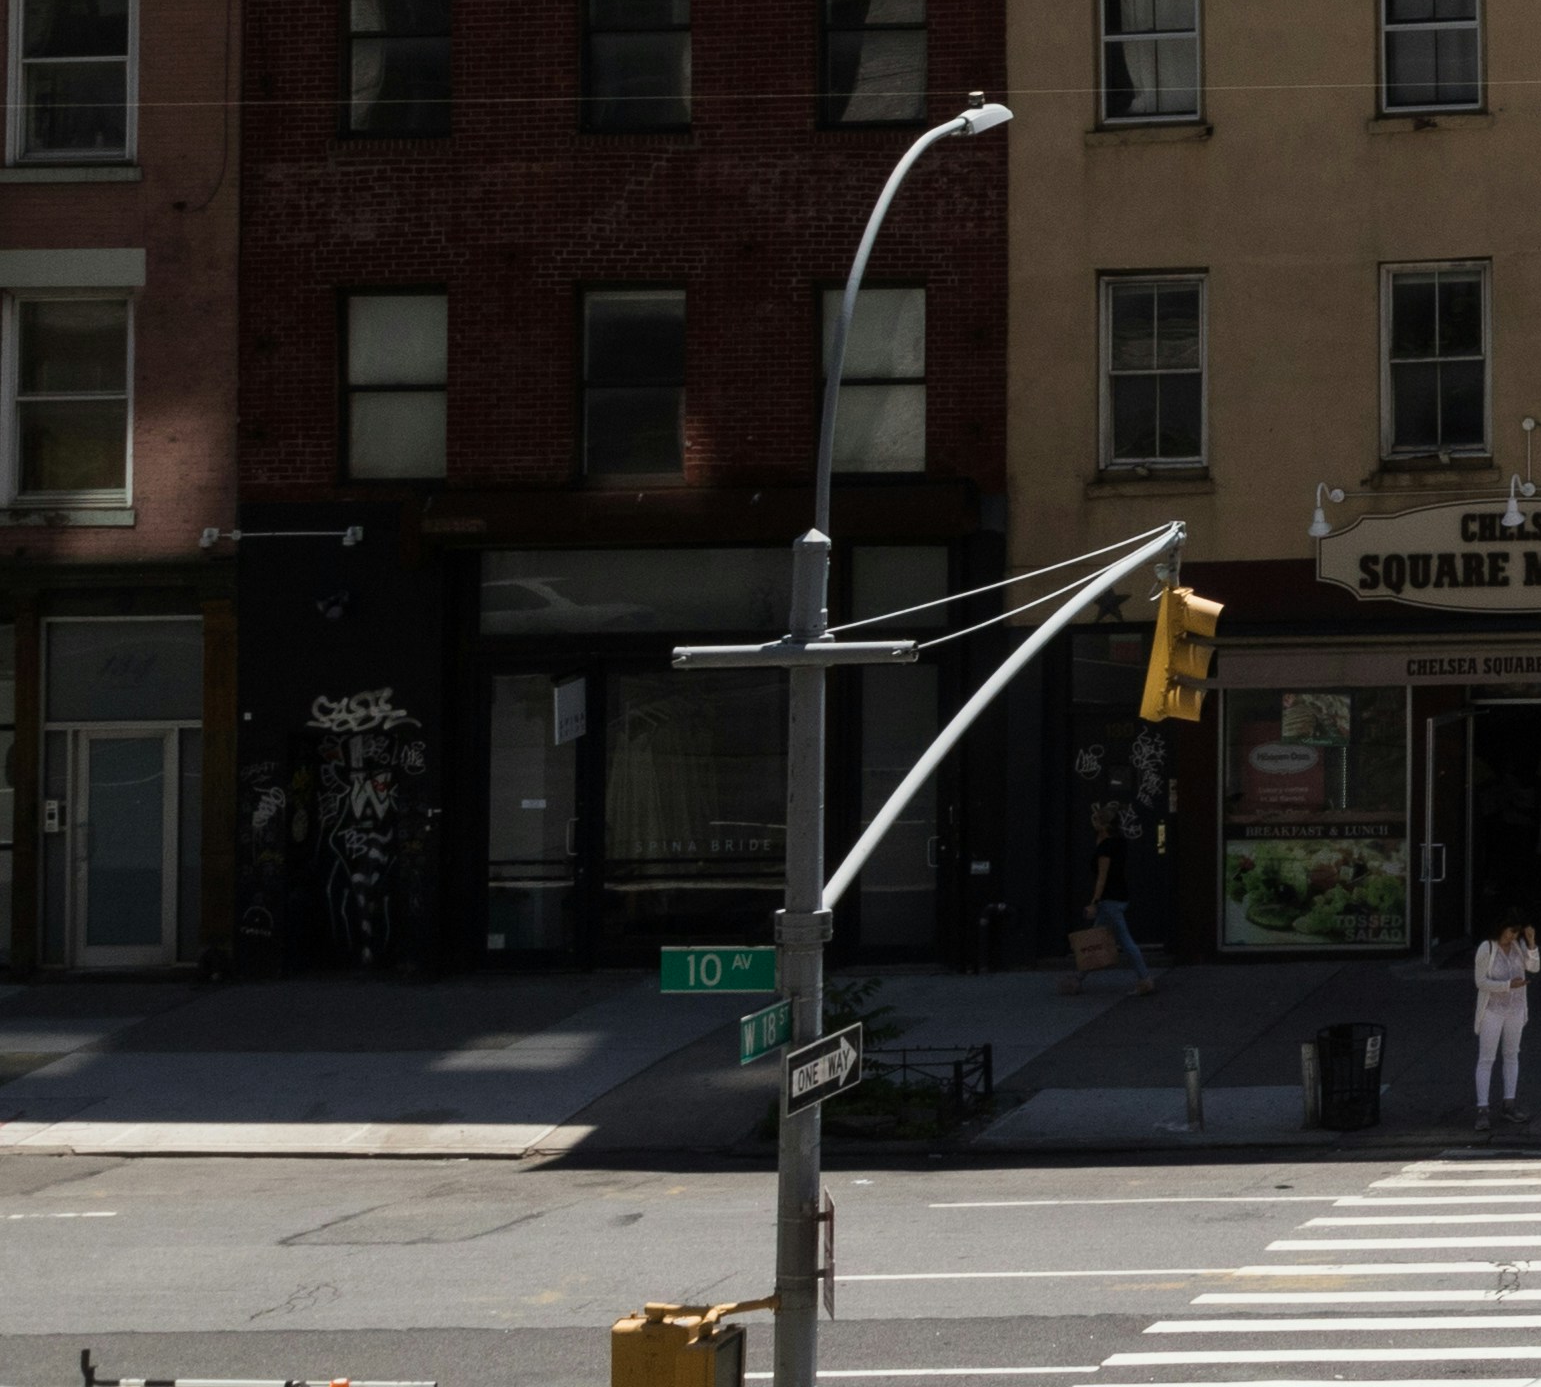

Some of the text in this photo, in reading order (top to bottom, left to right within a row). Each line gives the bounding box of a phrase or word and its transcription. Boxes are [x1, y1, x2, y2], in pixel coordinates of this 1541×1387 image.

[1359, 550, 1510, 593] SQUARE
[1406, 657, 1478, 677] CHELSEA
[1245, 824, 1389, 837] BREAKFAST & LUNCH
[635, 838, 772, 853] SPINA BRIDE
[1335, 914, 1404, 927] TOSSED
[1344, 928, 1403, 942] SALAD
[686, 953, 753, 988] 10 AV
[743, 1005, 791, 1056] W 18 ST
[799, 1048, 851, 1092] ONE WAY
